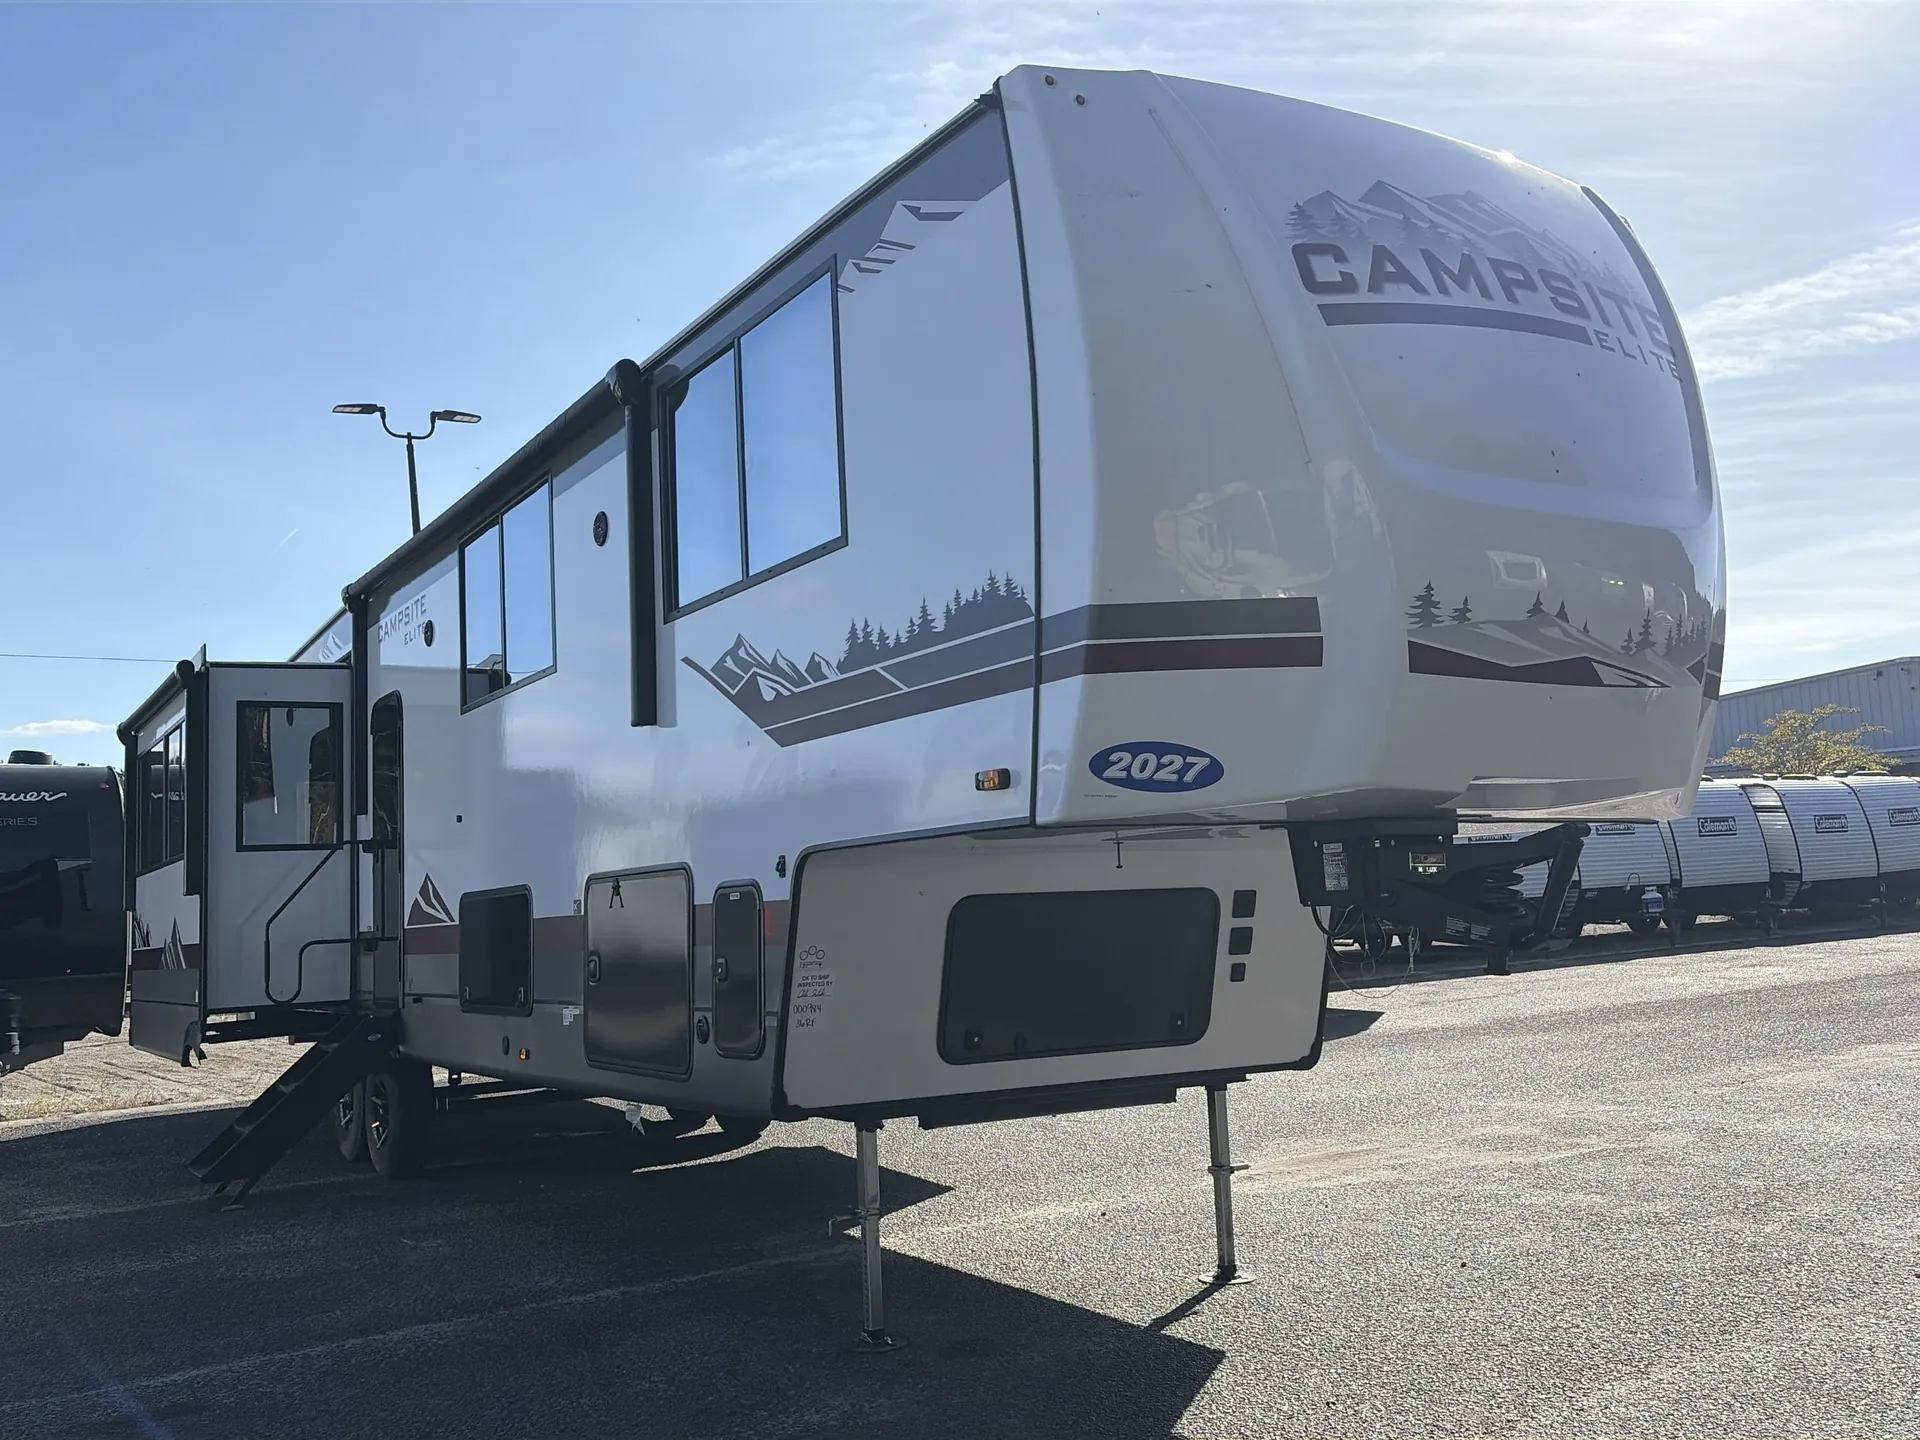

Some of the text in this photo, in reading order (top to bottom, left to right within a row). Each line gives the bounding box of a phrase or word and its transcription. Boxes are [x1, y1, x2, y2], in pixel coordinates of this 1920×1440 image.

[1290, 242, 1677, 357] CAMPSITE
[1592, 329, 1683, 382] ELITE
[378, 594, 426, 644] CAMPSITE
[1102, 751, 1211, 783] 2027
[1699, 818, 1729, 833] Coleman
[1815, 815, 1842, 830] Coleman
[1889, 808, 1914, 823] Coleman
